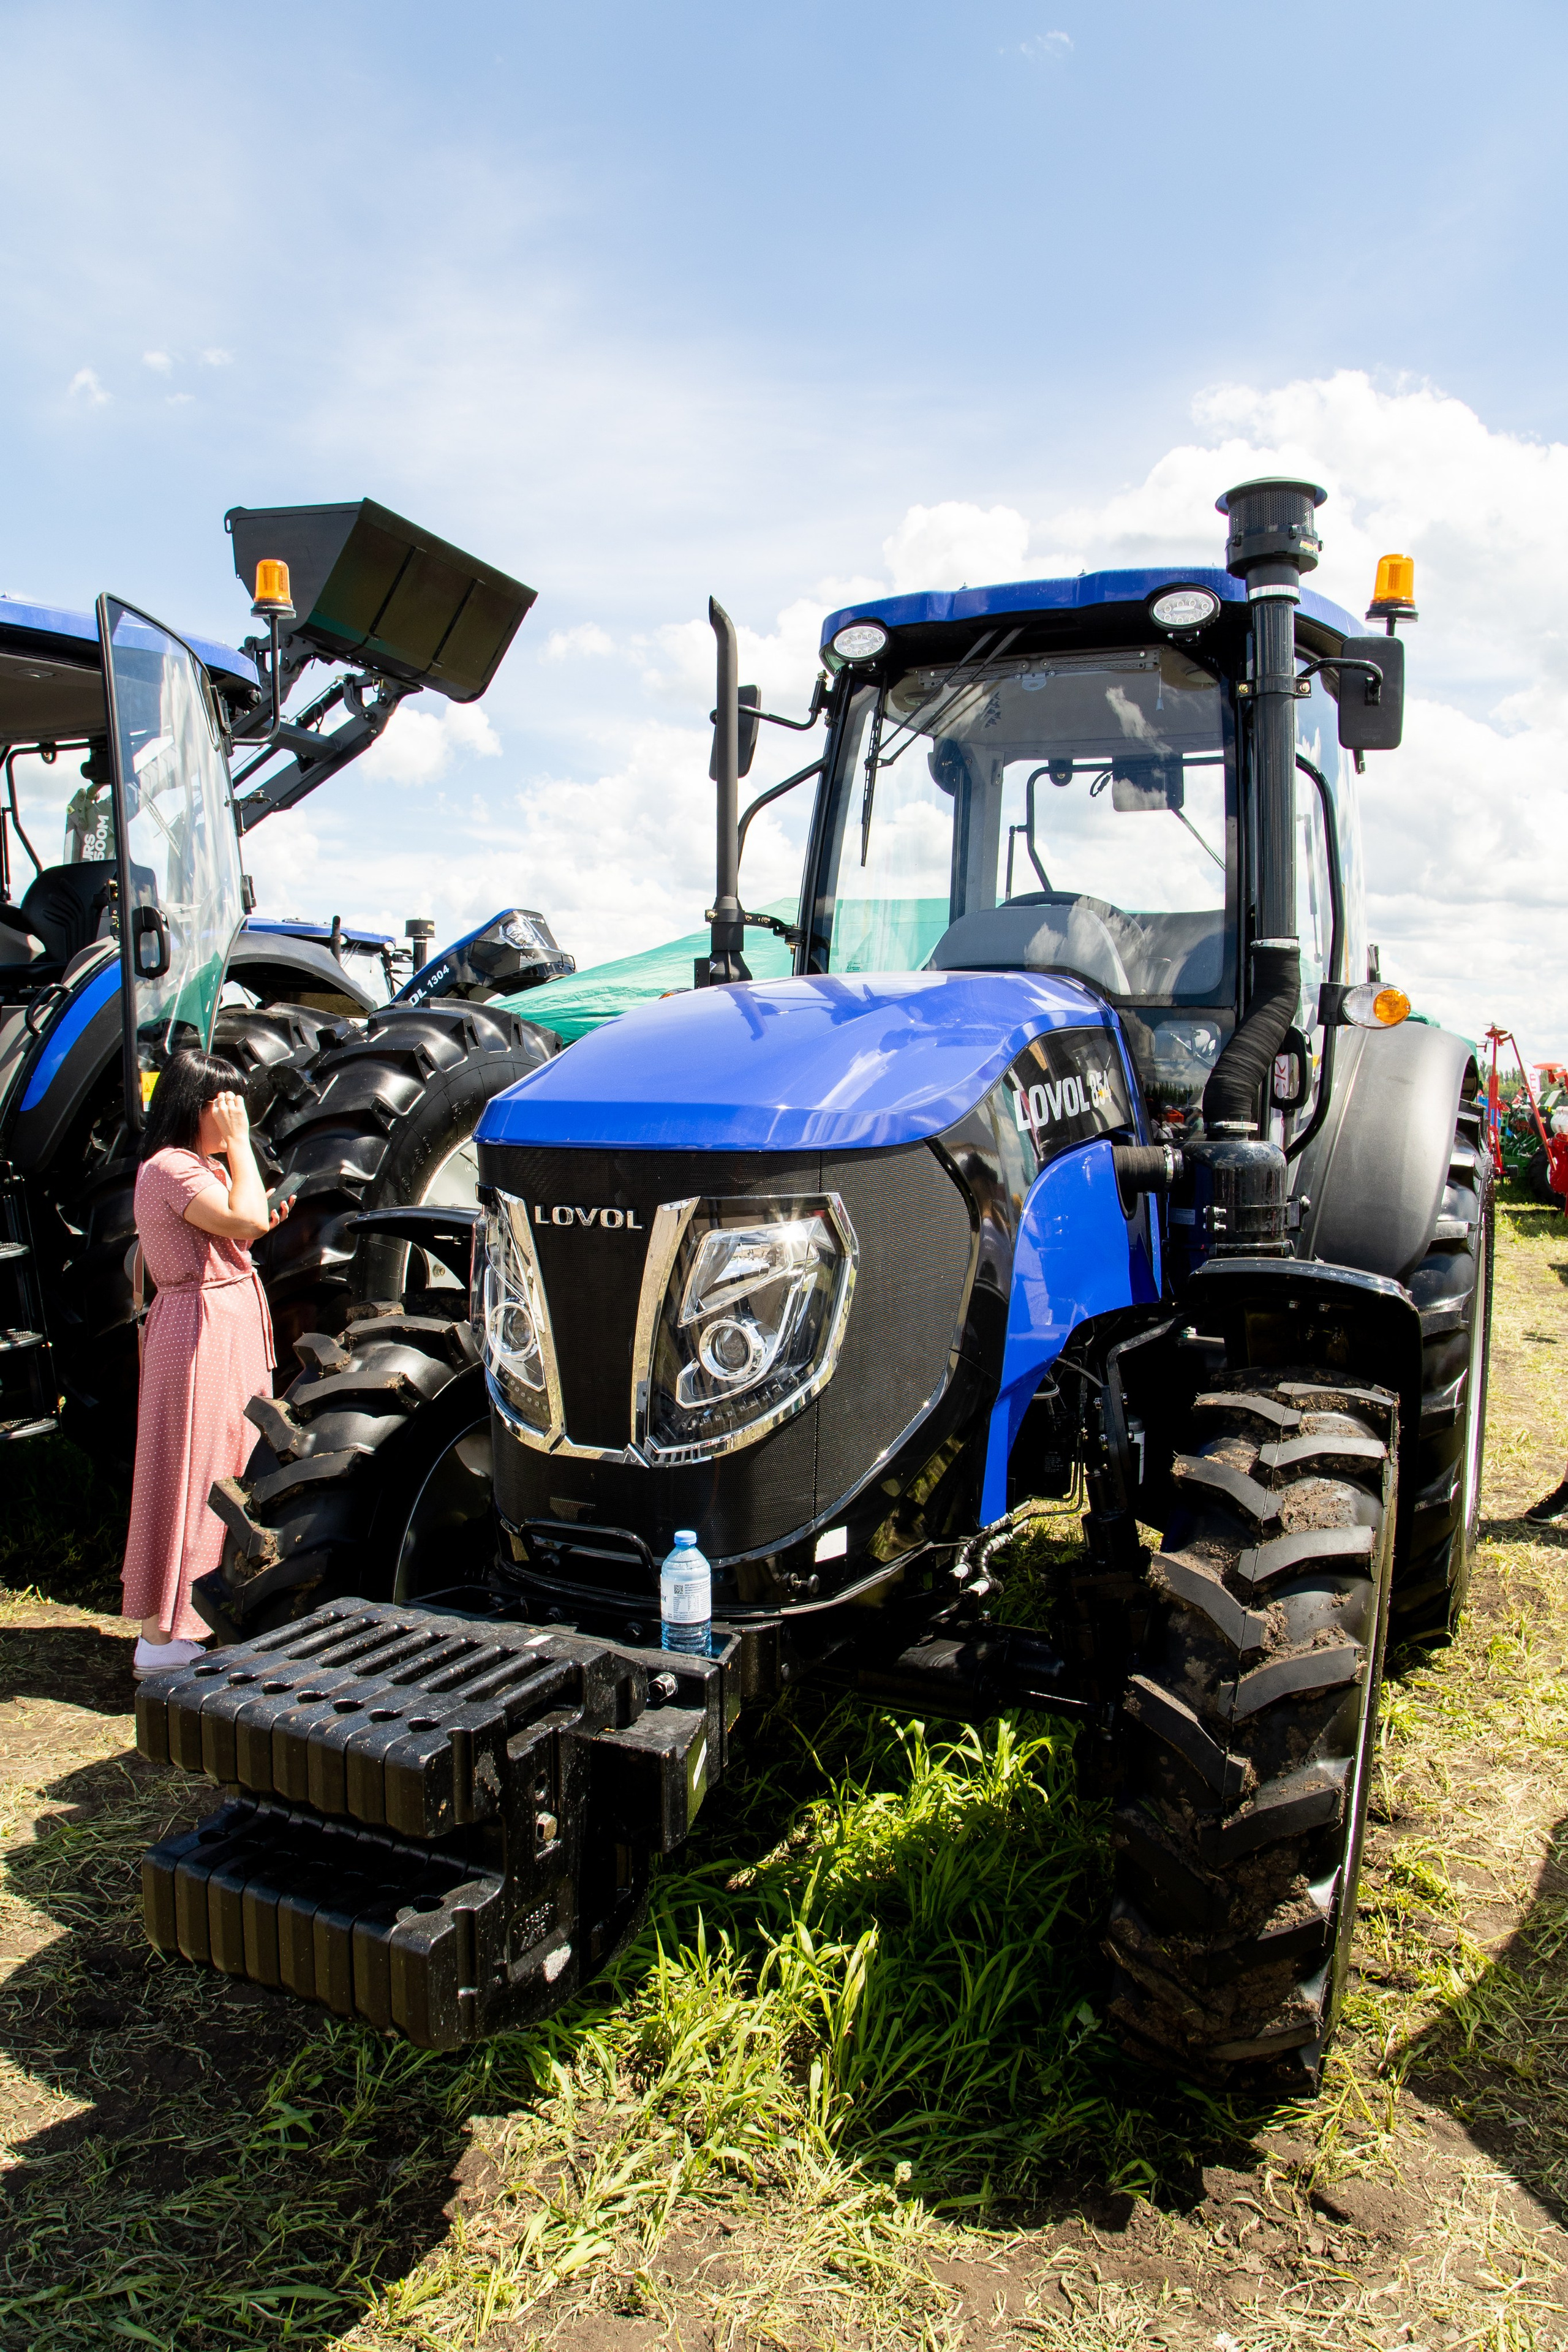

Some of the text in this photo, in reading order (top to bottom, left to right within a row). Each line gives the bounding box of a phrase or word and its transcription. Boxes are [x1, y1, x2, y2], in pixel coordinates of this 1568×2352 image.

[427, 964, 450, 988] 1304
[1012, 1070, 1112, 1132] LOVOL 854
[534, 1205, 643, 1230] LOVOL
